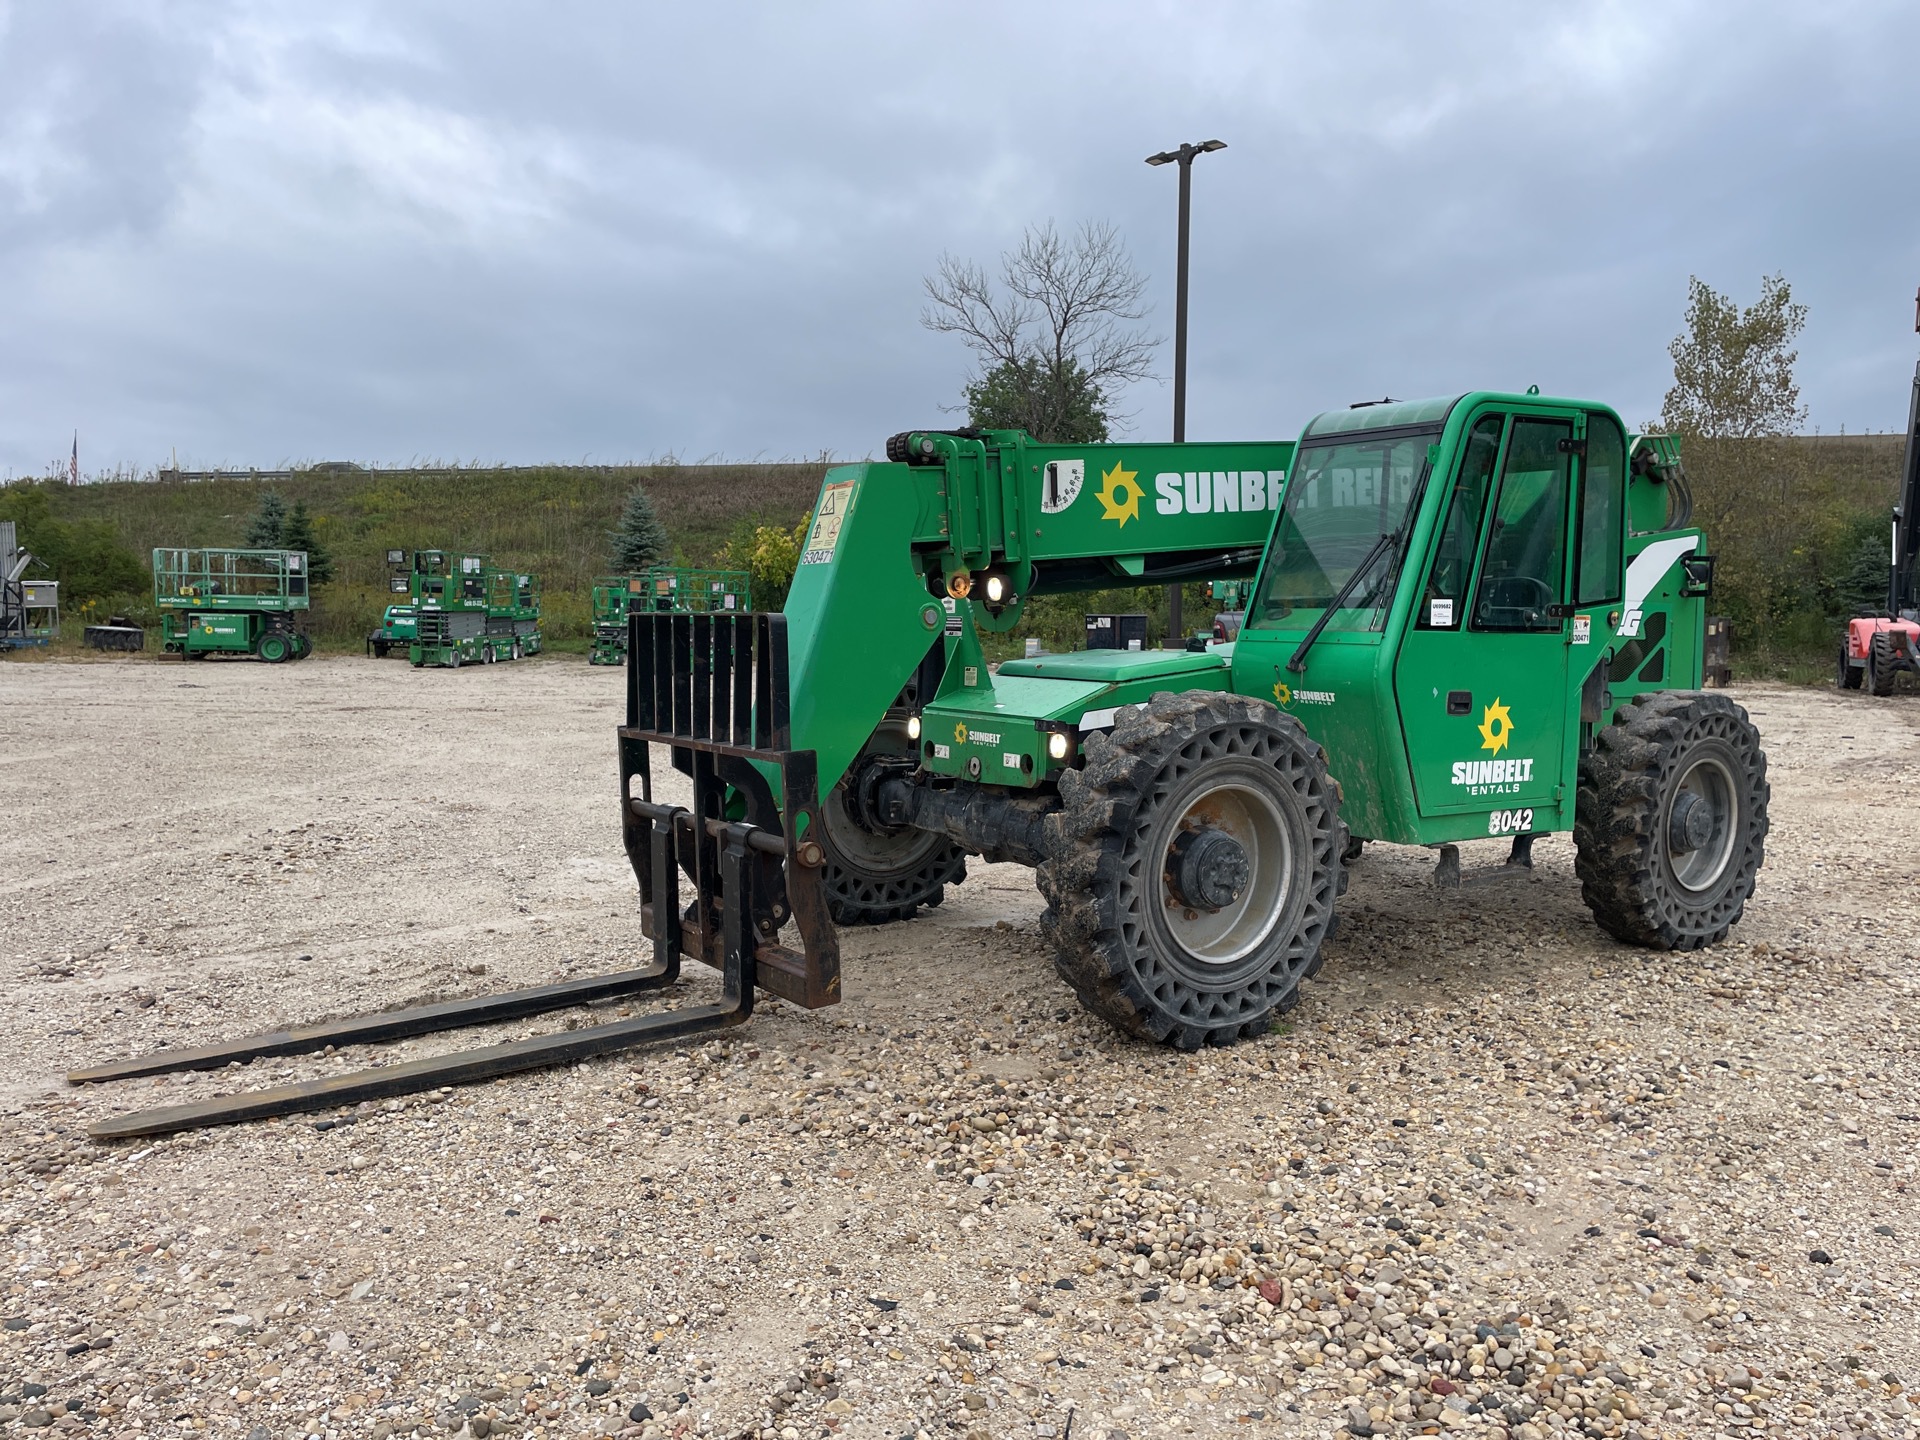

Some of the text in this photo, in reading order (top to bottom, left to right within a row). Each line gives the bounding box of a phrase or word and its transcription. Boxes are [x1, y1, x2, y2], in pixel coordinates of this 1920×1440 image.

[802, 550, 834, 565] 630471
[1292, 690, 1335, 702] SUNBELT
[969, 731, 1001, 744] SUNBELT
[1451, 758, 1533, 785] SUNBELT
[1466, 783, 1520, 796] ENTALS
[1488, 808, 1533, 835] 8042
